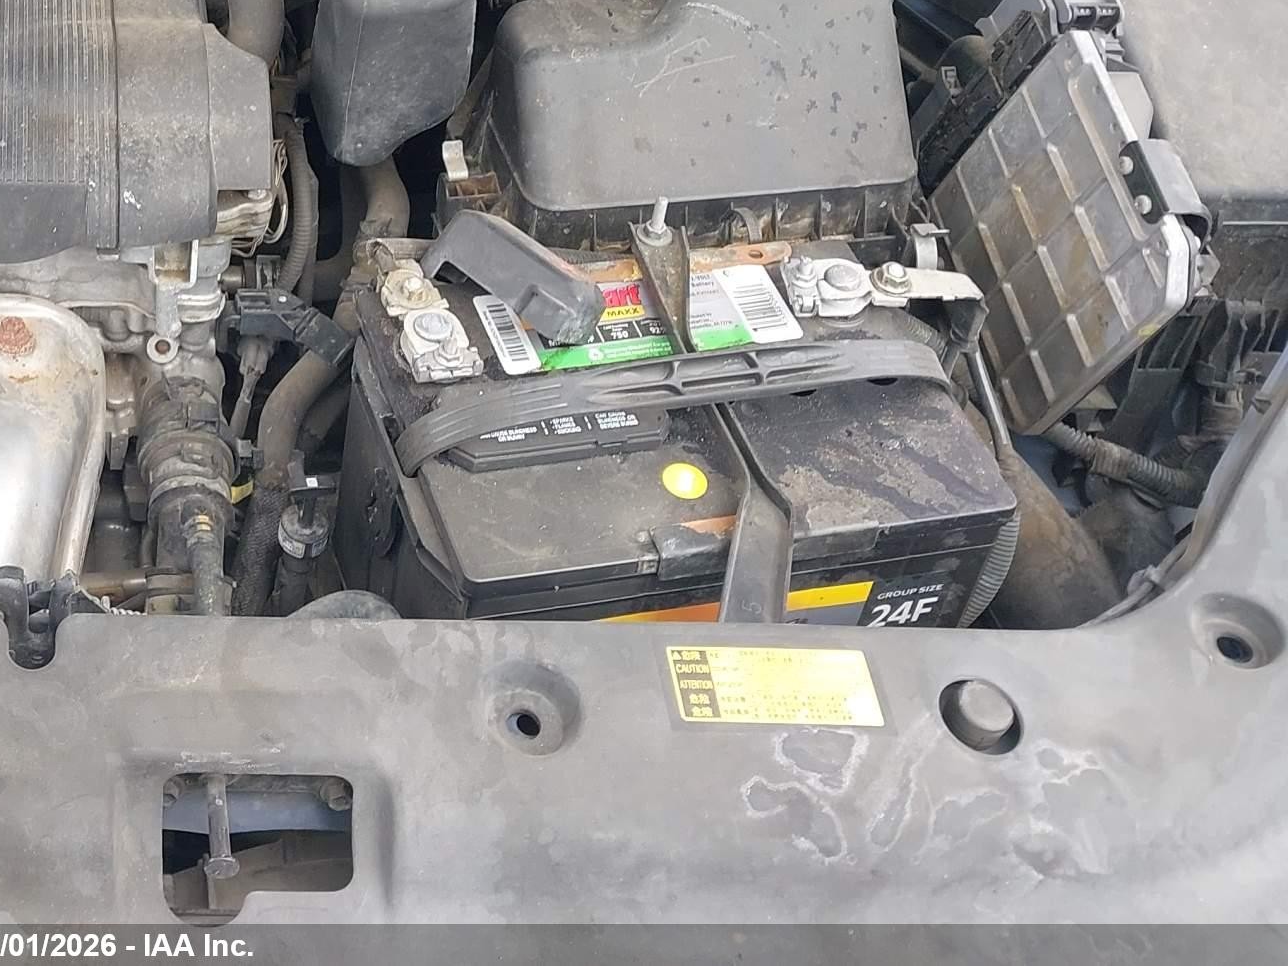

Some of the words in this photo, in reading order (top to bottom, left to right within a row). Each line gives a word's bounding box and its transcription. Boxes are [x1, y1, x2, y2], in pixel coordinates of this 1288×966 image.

[877, 587, 917, 600] GROUP
[918, 584, 945, 594] SIZE
[867, 596, 939, 627] 24F
[675, 663, 711, 674] CAUTION
